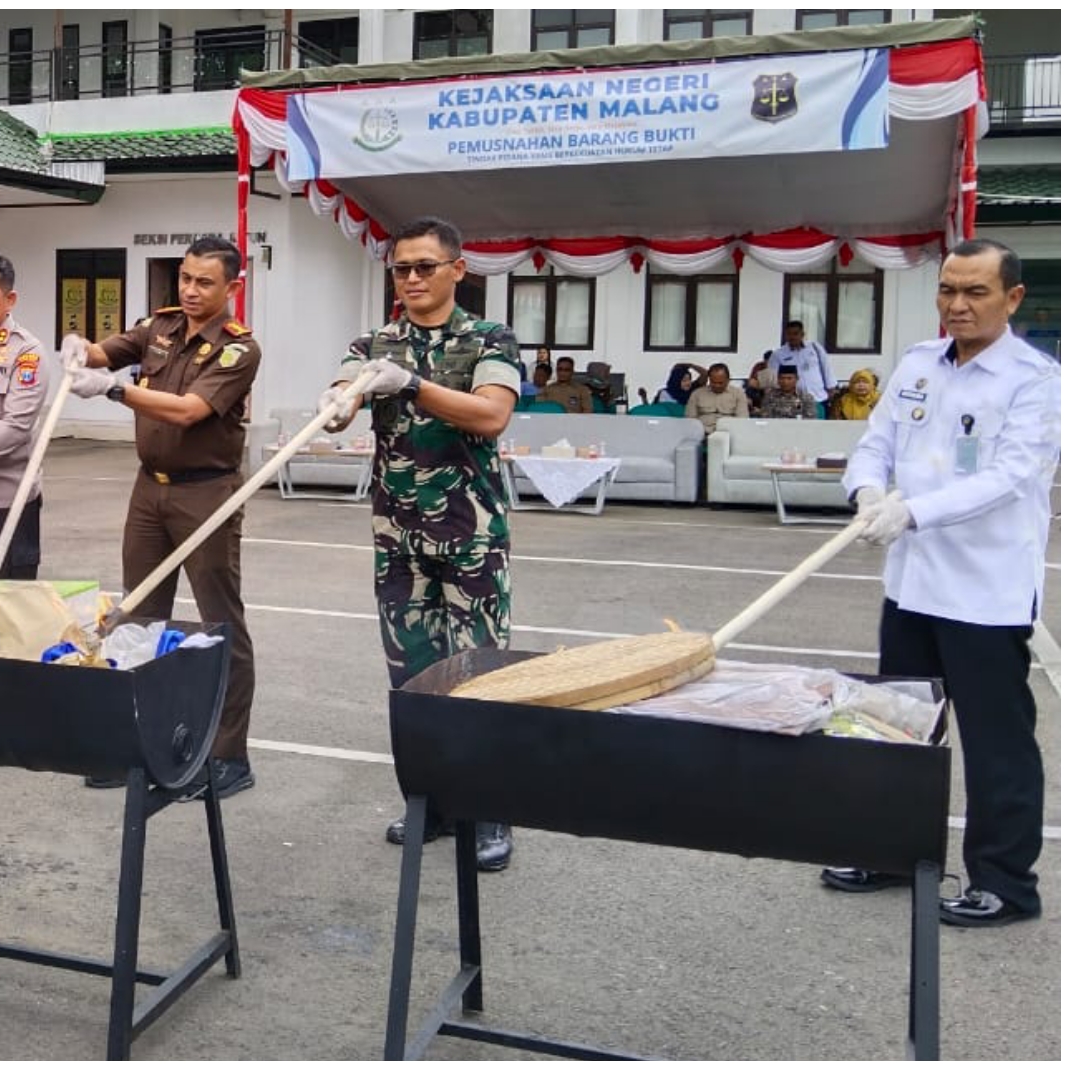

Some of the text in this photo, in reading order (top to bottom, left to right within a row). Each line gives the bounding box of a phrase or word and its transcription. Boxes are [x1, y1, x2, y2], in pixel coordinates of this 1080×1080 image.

[438, 73, 709, 107] KEJAKSAAN NEGERI
[428, 102, 589, 130] KABUPATEN
[599, 93, 720, 119] MALANG
[448, 134, 563, 154] PEMUSNAHAN
[568, 130, 639, 148] BARANG
[644, 127, 696, 143] BUKTI
